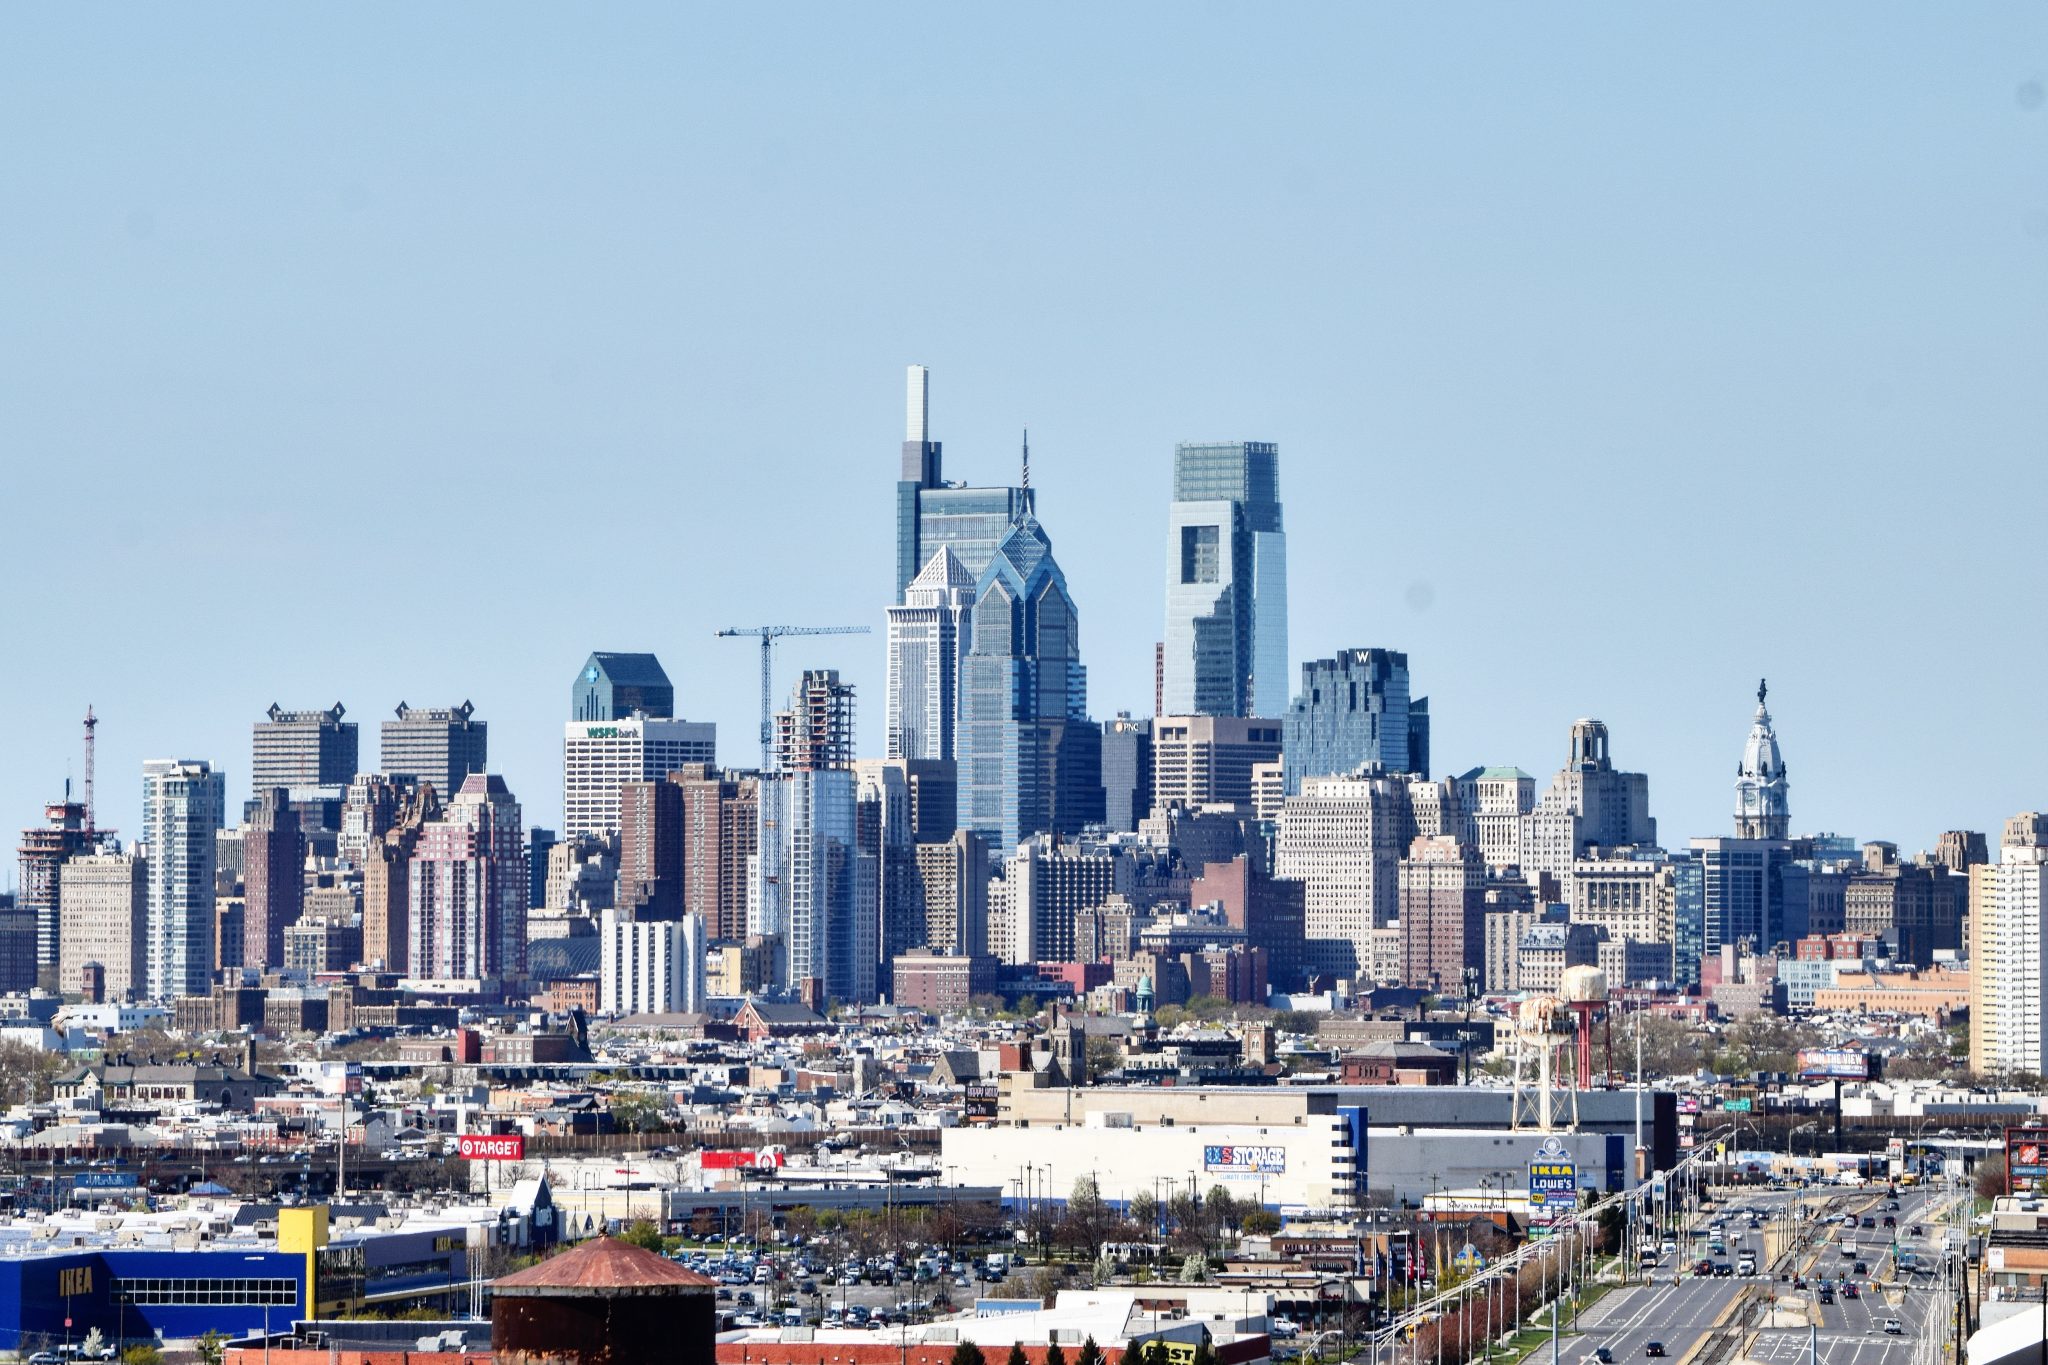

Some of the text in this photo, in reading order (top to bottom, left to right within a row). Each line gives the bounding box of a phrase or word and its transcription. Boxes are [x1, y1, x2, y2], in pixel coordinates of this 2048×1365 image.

[1356, 651, 1369, 663] W
[587, 727, 617, 738] WSFS
[1123, 722, 1139, 731] PNC
[1806, 1053, 1862, 1065] OWN THE VIEW
[474, 1141, 519, 1155] TARGET
[1232, 1147, 1284, 1165] STORAGE
[1531, 1166, 1573, 1175] IKEA
[1533, 1178, 1572, 1189] LOWE'S
[60, 1266, 93, 1297] IKEA
[1146, 1346, 1194, 1361] BST
